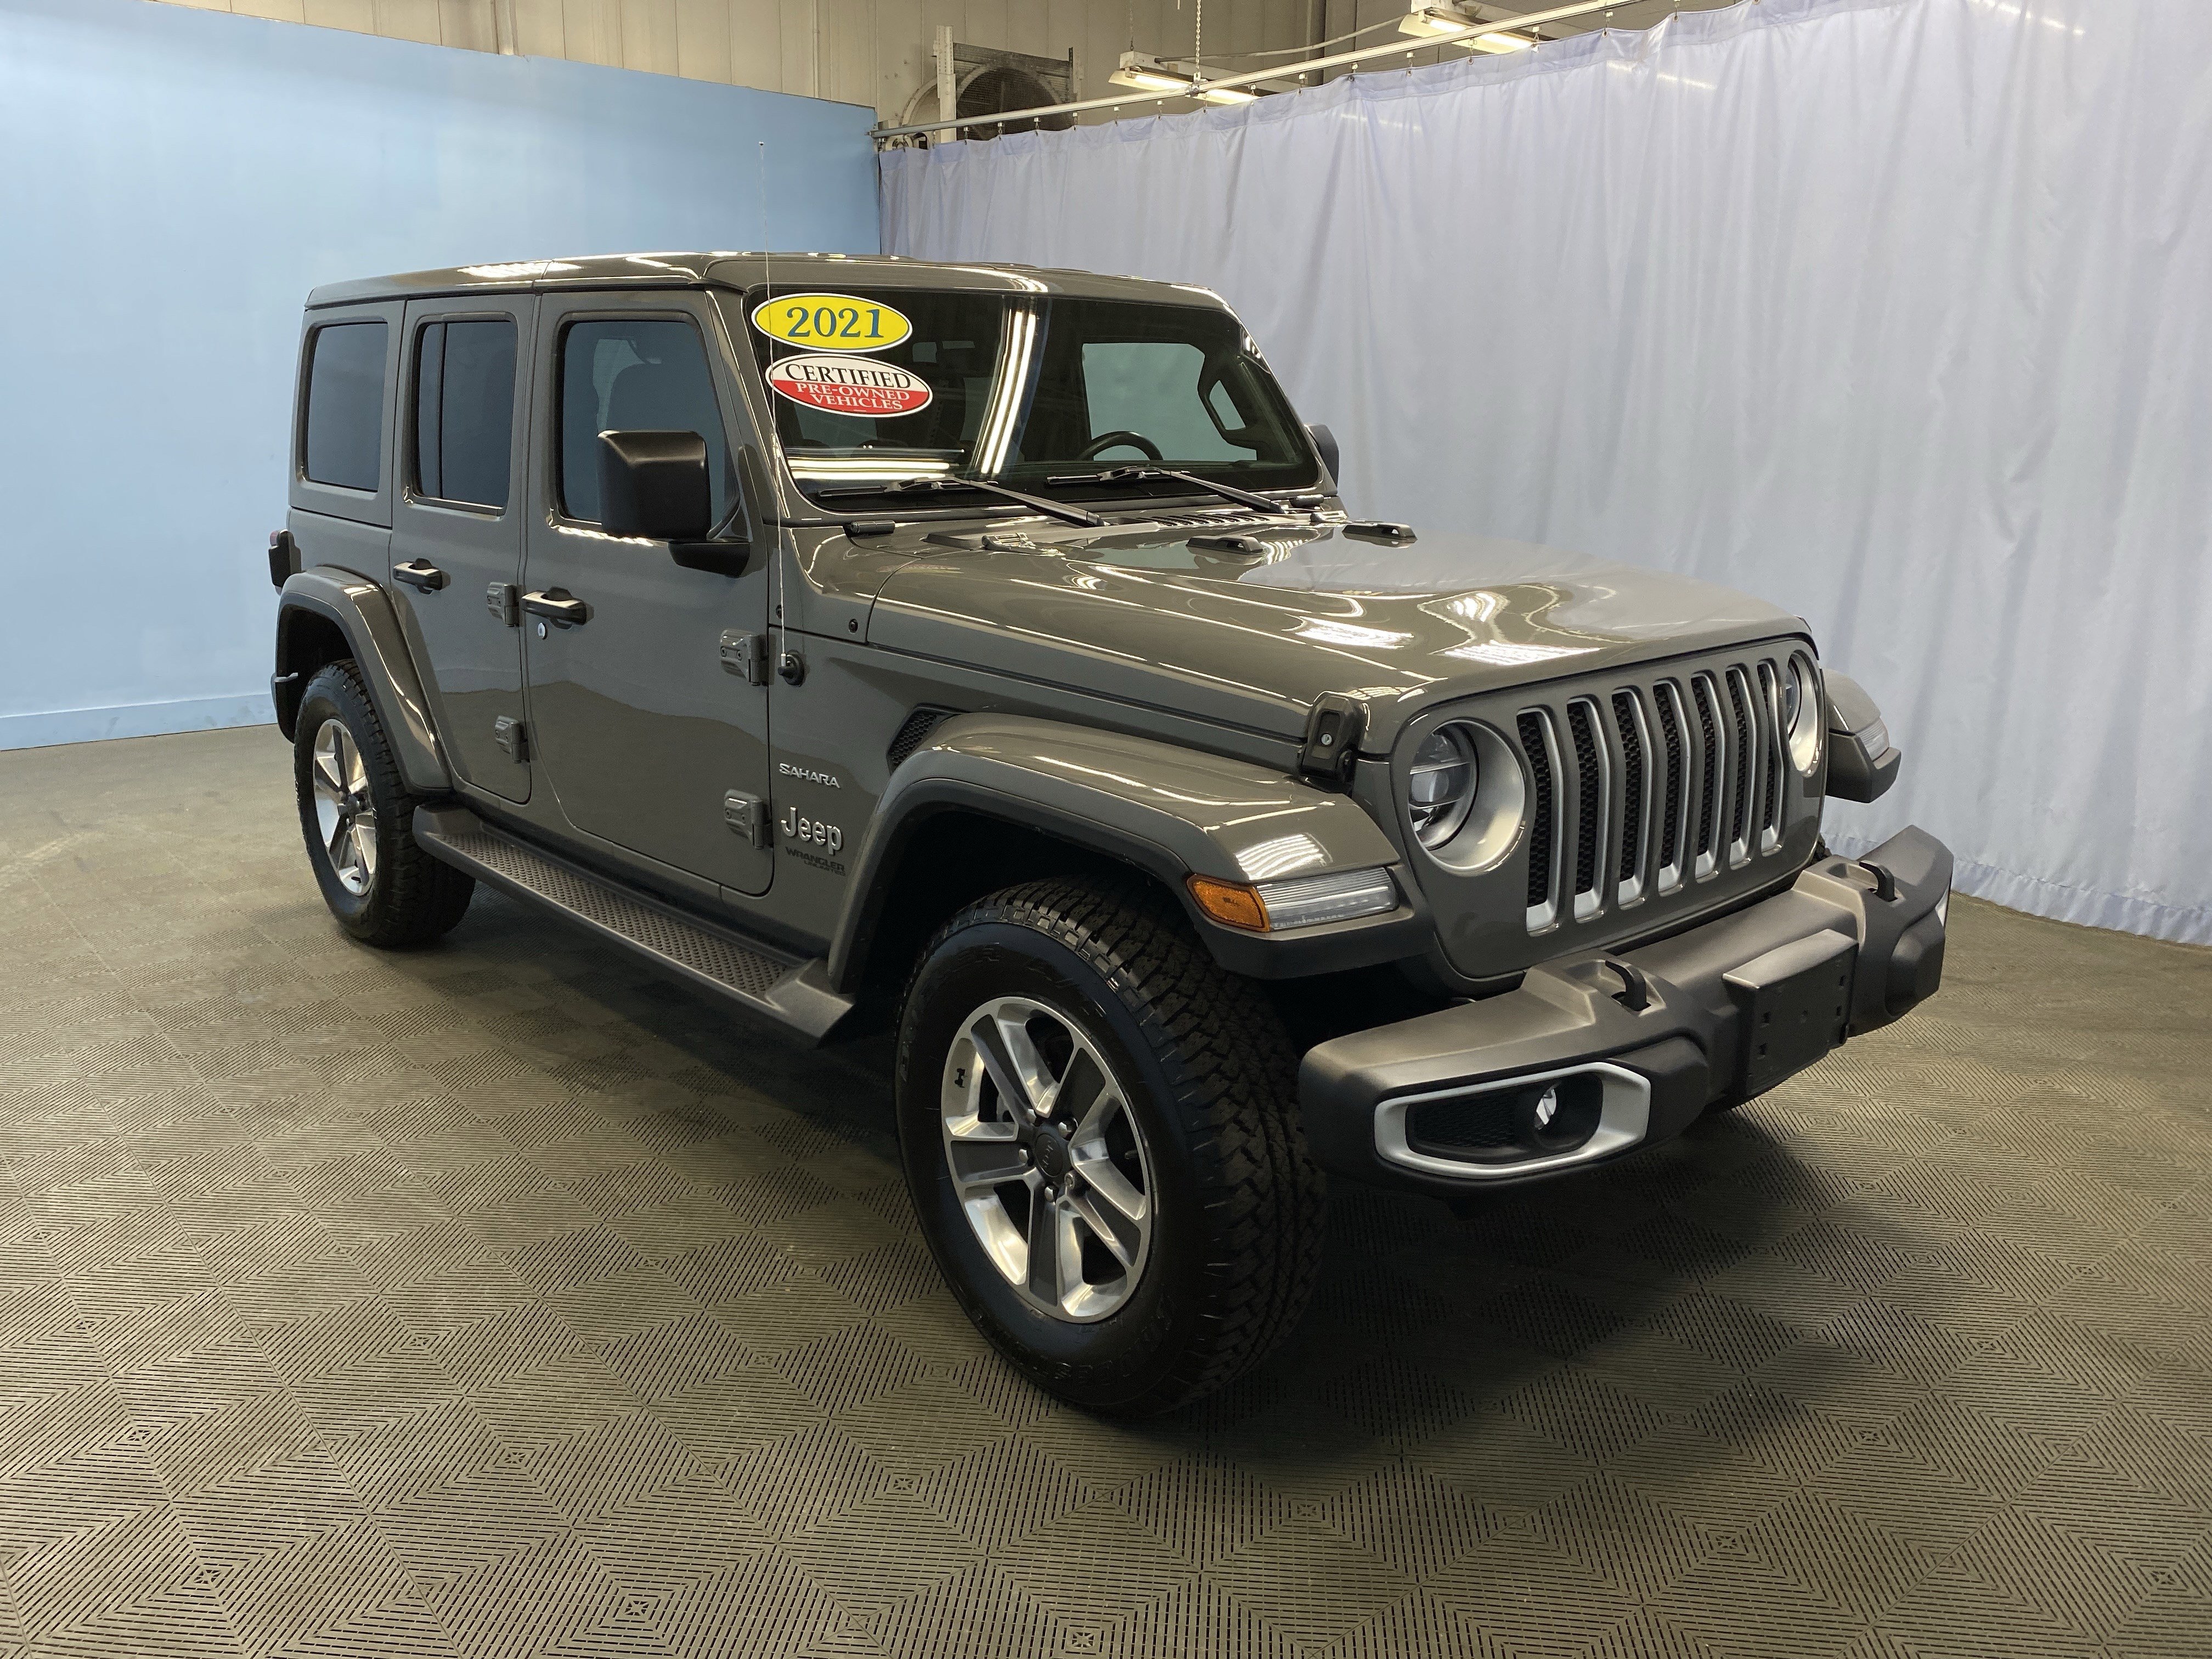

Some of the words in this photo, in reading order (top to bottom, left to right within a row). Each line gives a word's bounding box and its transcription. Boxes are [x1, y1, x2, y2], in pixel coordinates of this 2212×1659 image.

[787, 307, 884, 337] 2021
[785, 363, 911, 388] CERTIFIED
[796, 383, 910, 401] PRE-OWNED
[810, 394, 903, 410] VEHICLES
[779, 763, 842, 789] SAHARA
[781, 806, 843, 855] Jeep
